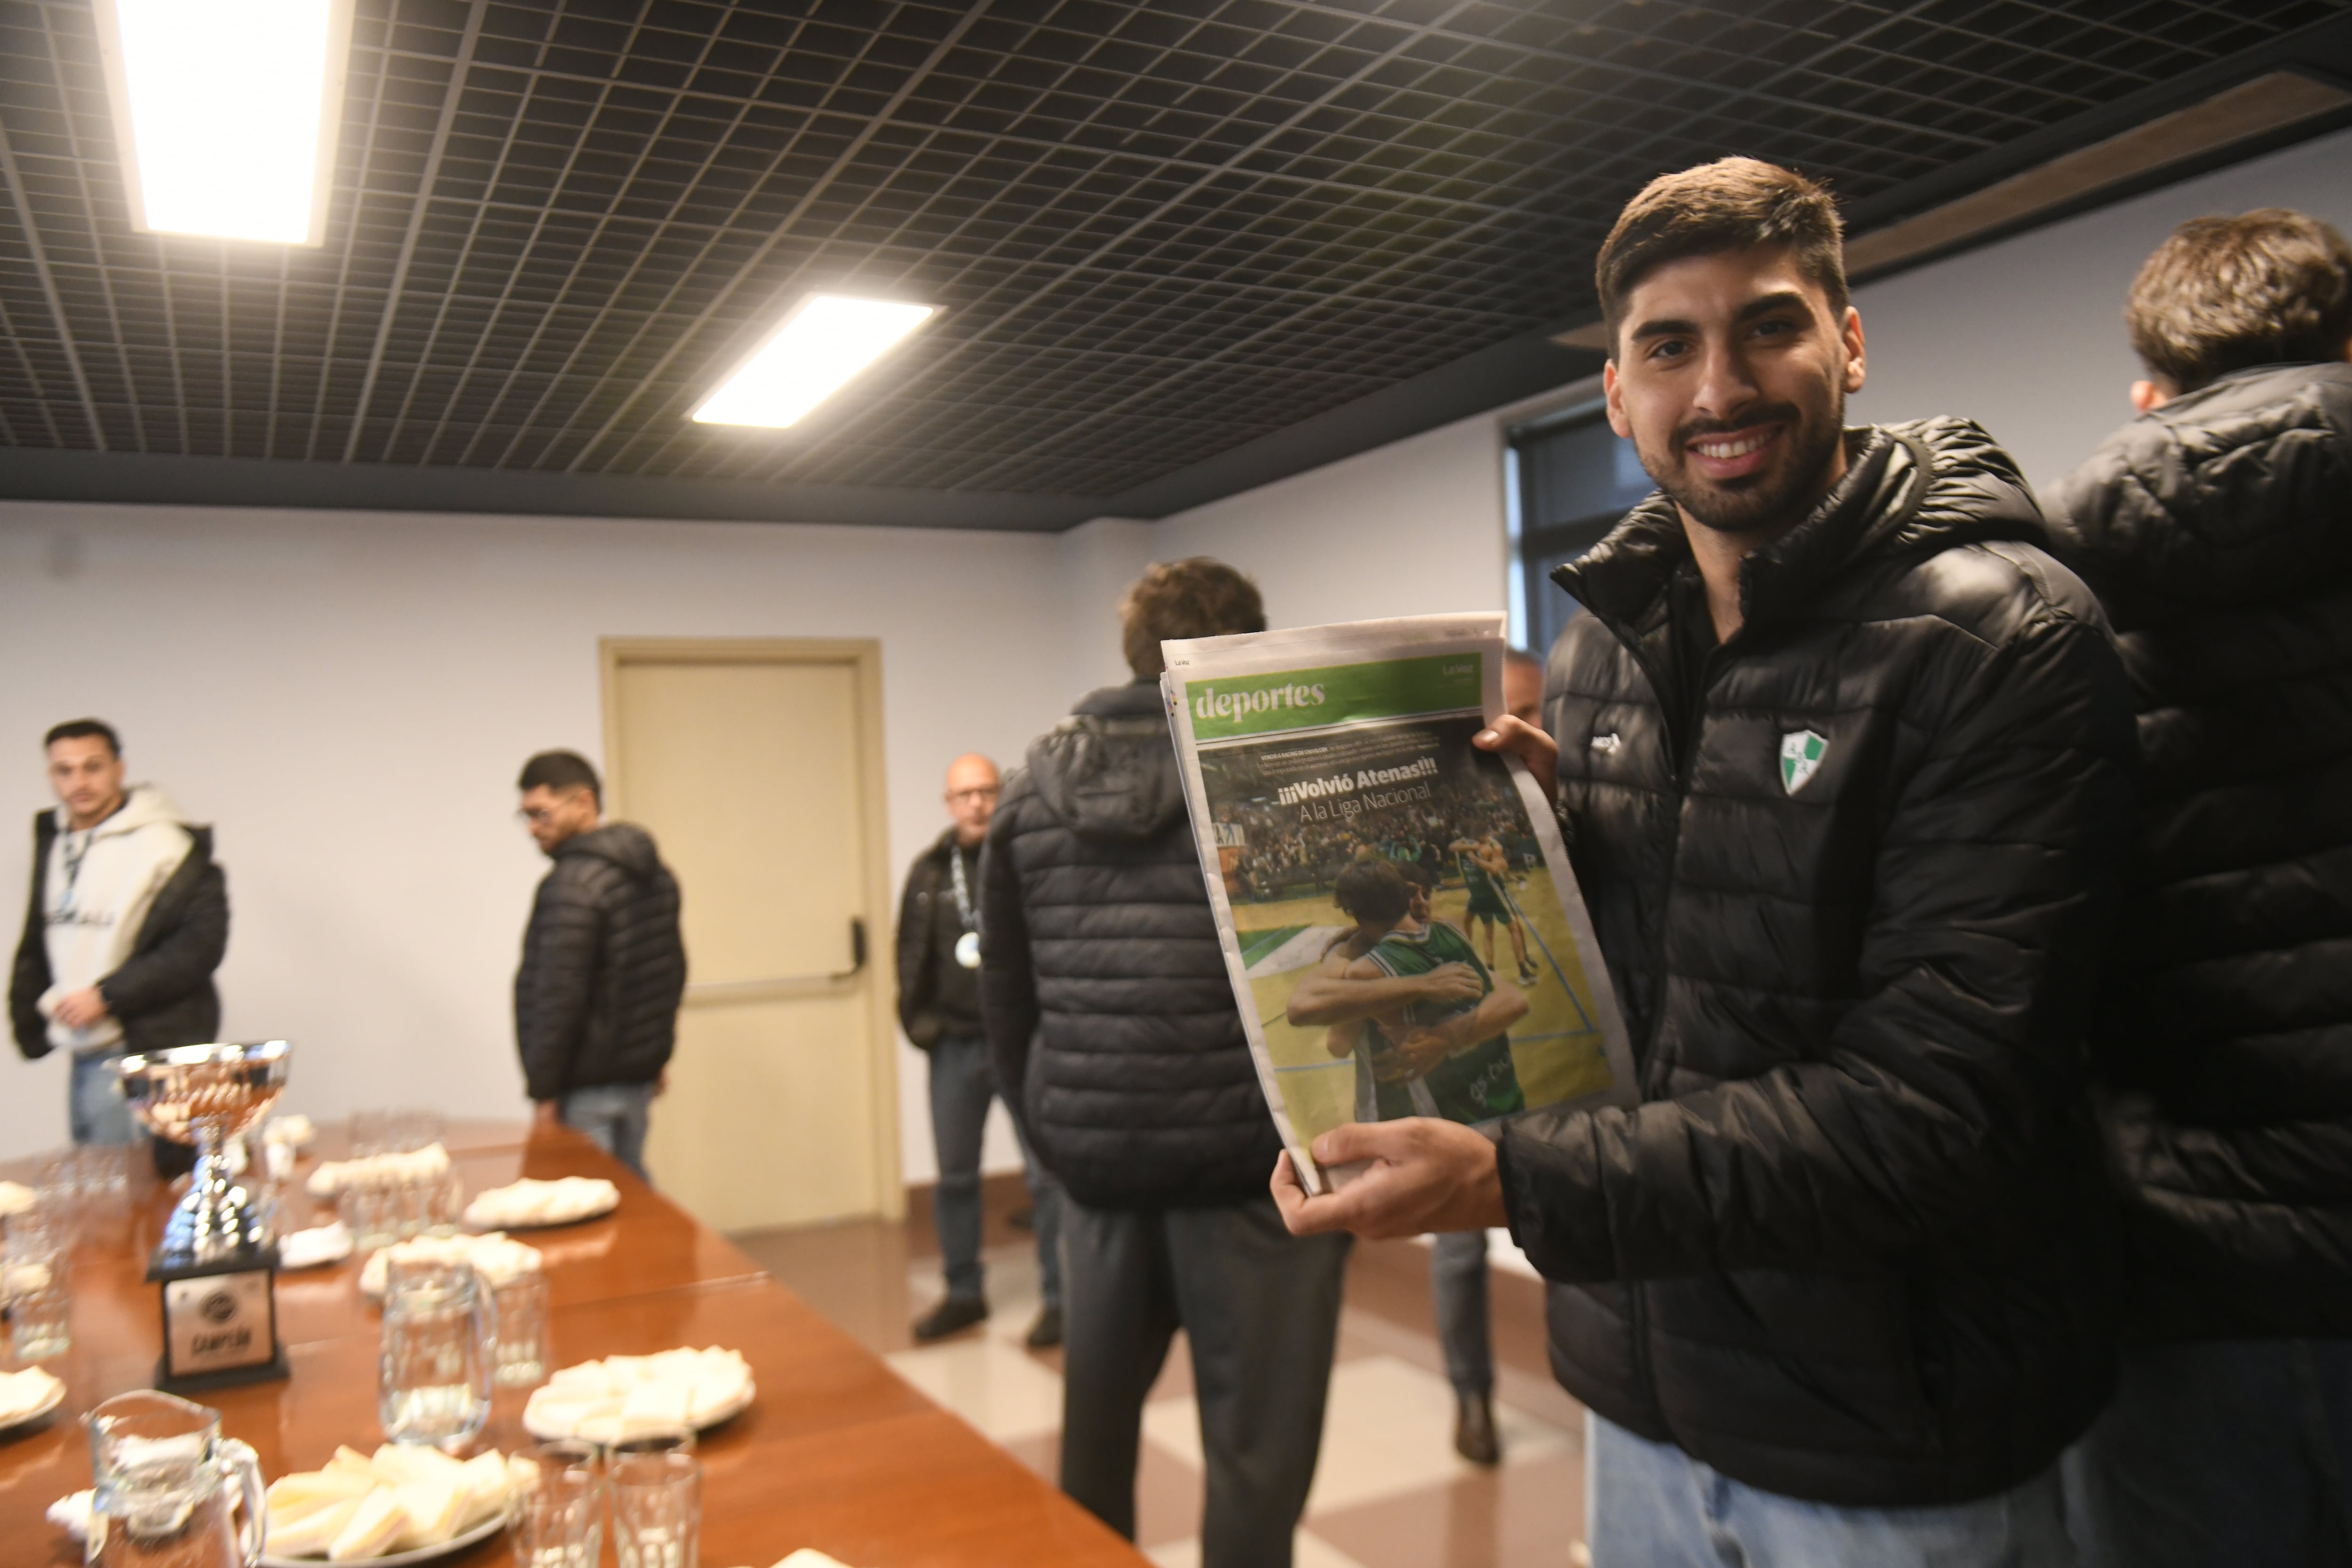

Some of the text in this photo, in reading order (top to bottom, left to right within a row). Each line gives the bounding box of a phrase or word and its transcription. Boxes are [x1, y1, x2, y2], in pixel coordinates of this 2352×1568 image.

[1196, 683, 1325, 722] deportes
[1278, 757, 1438, 805] ¡¡¡Volvió Atenas!!!
[1300, 780, 1432, 822] A la Liga Nacional
